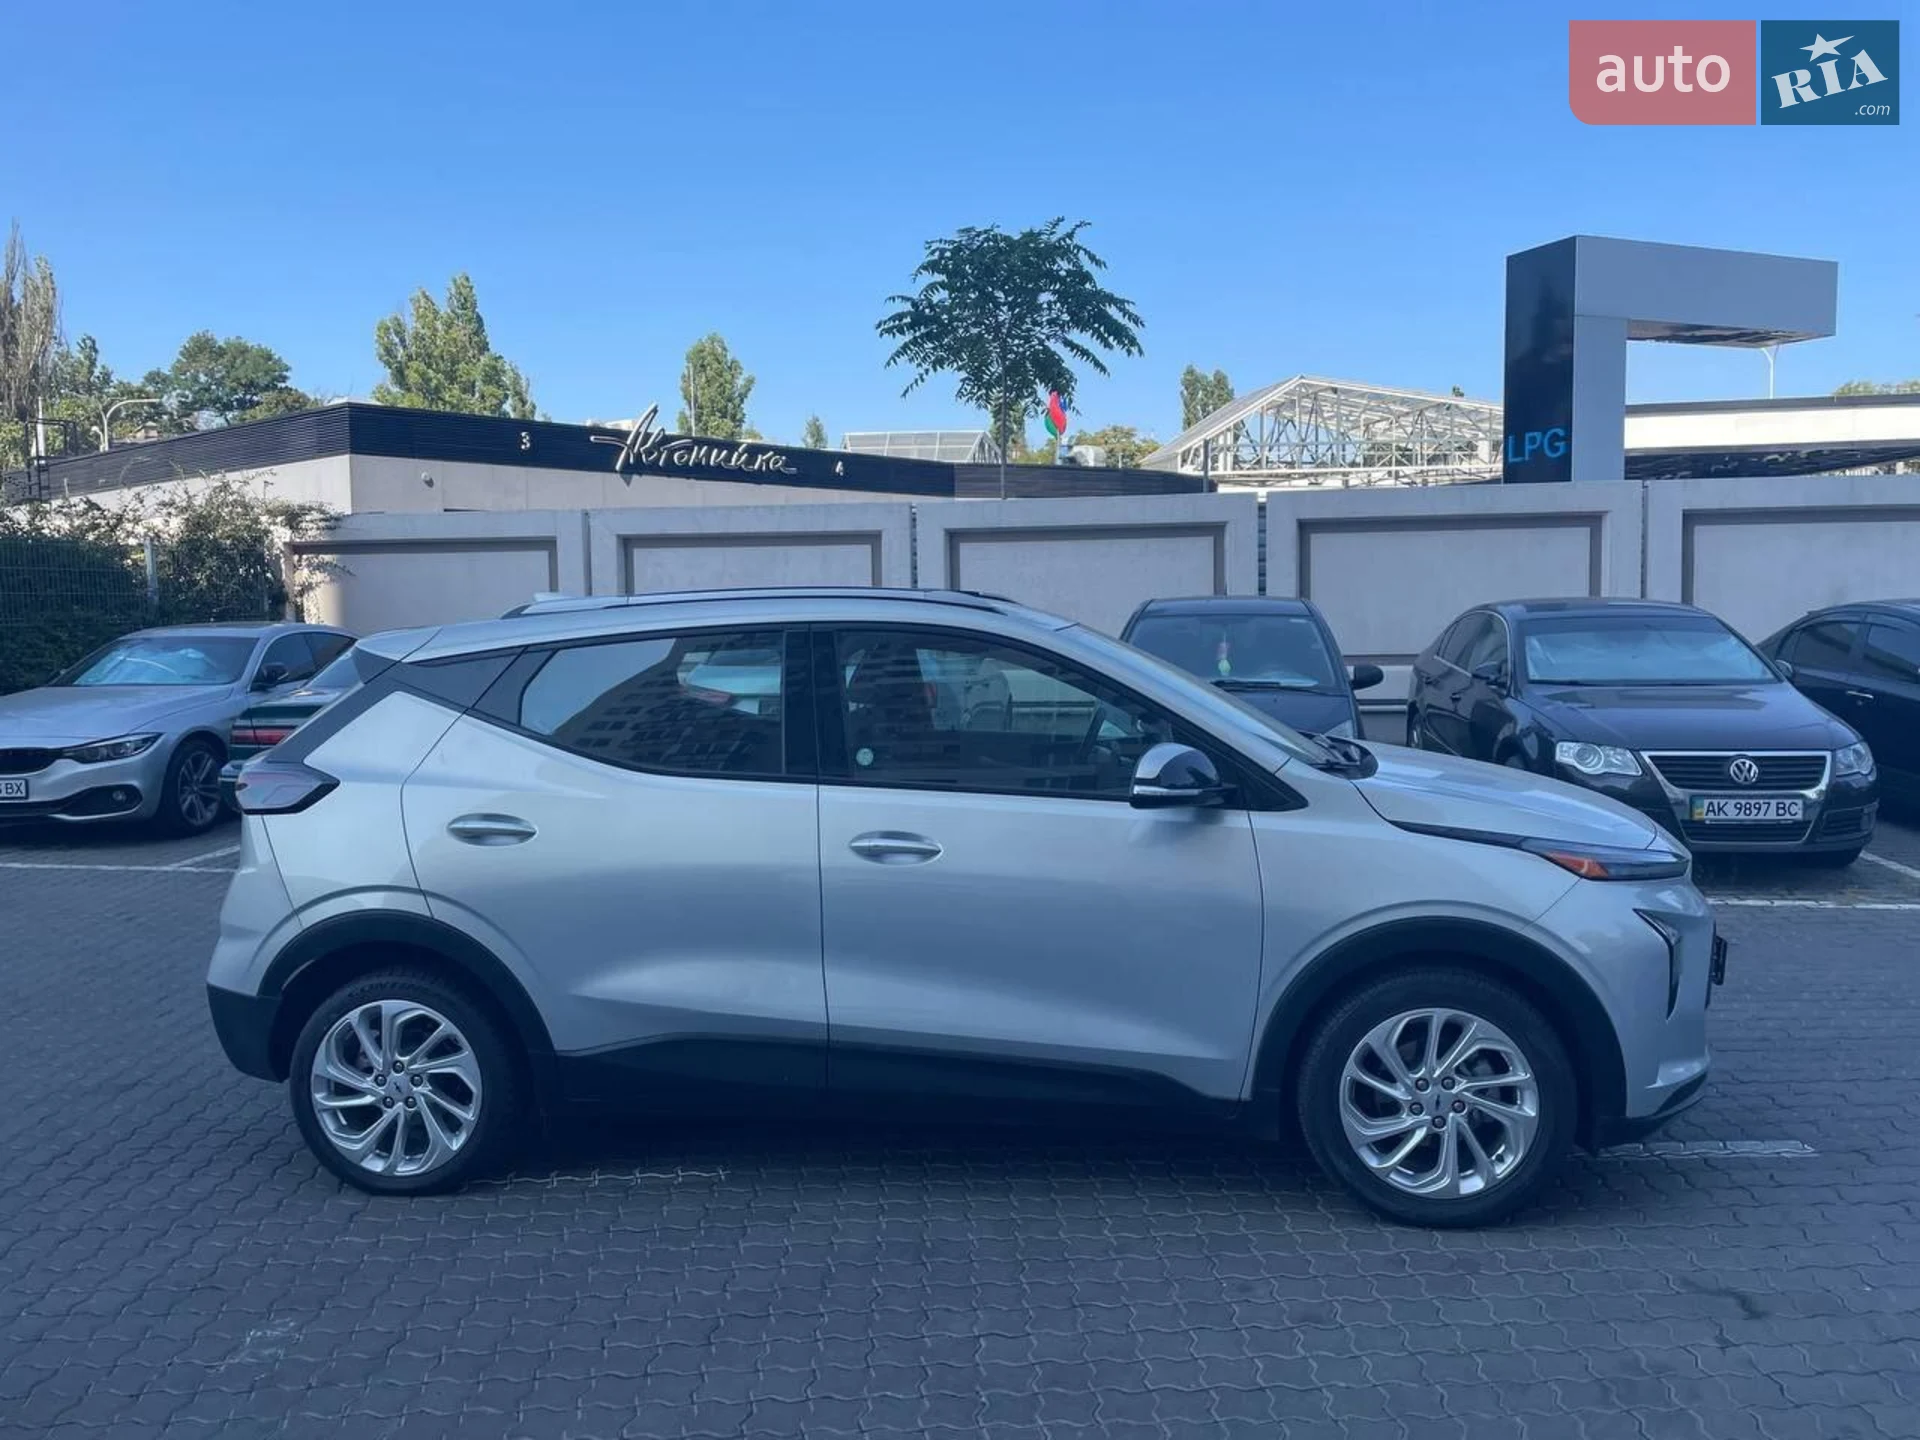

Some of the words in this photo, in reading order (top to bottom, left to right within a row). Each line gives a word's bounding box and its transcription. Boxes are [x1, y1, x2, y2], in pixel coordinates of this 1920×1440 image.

[521, 431, 531, 450] 3
[1508, 428, 1567, 463] LPG
[1705, 801, 1729, 817] AK
[1734, 801, 1771, 817] 9897
[1776, 801, 1798, 817] BC
